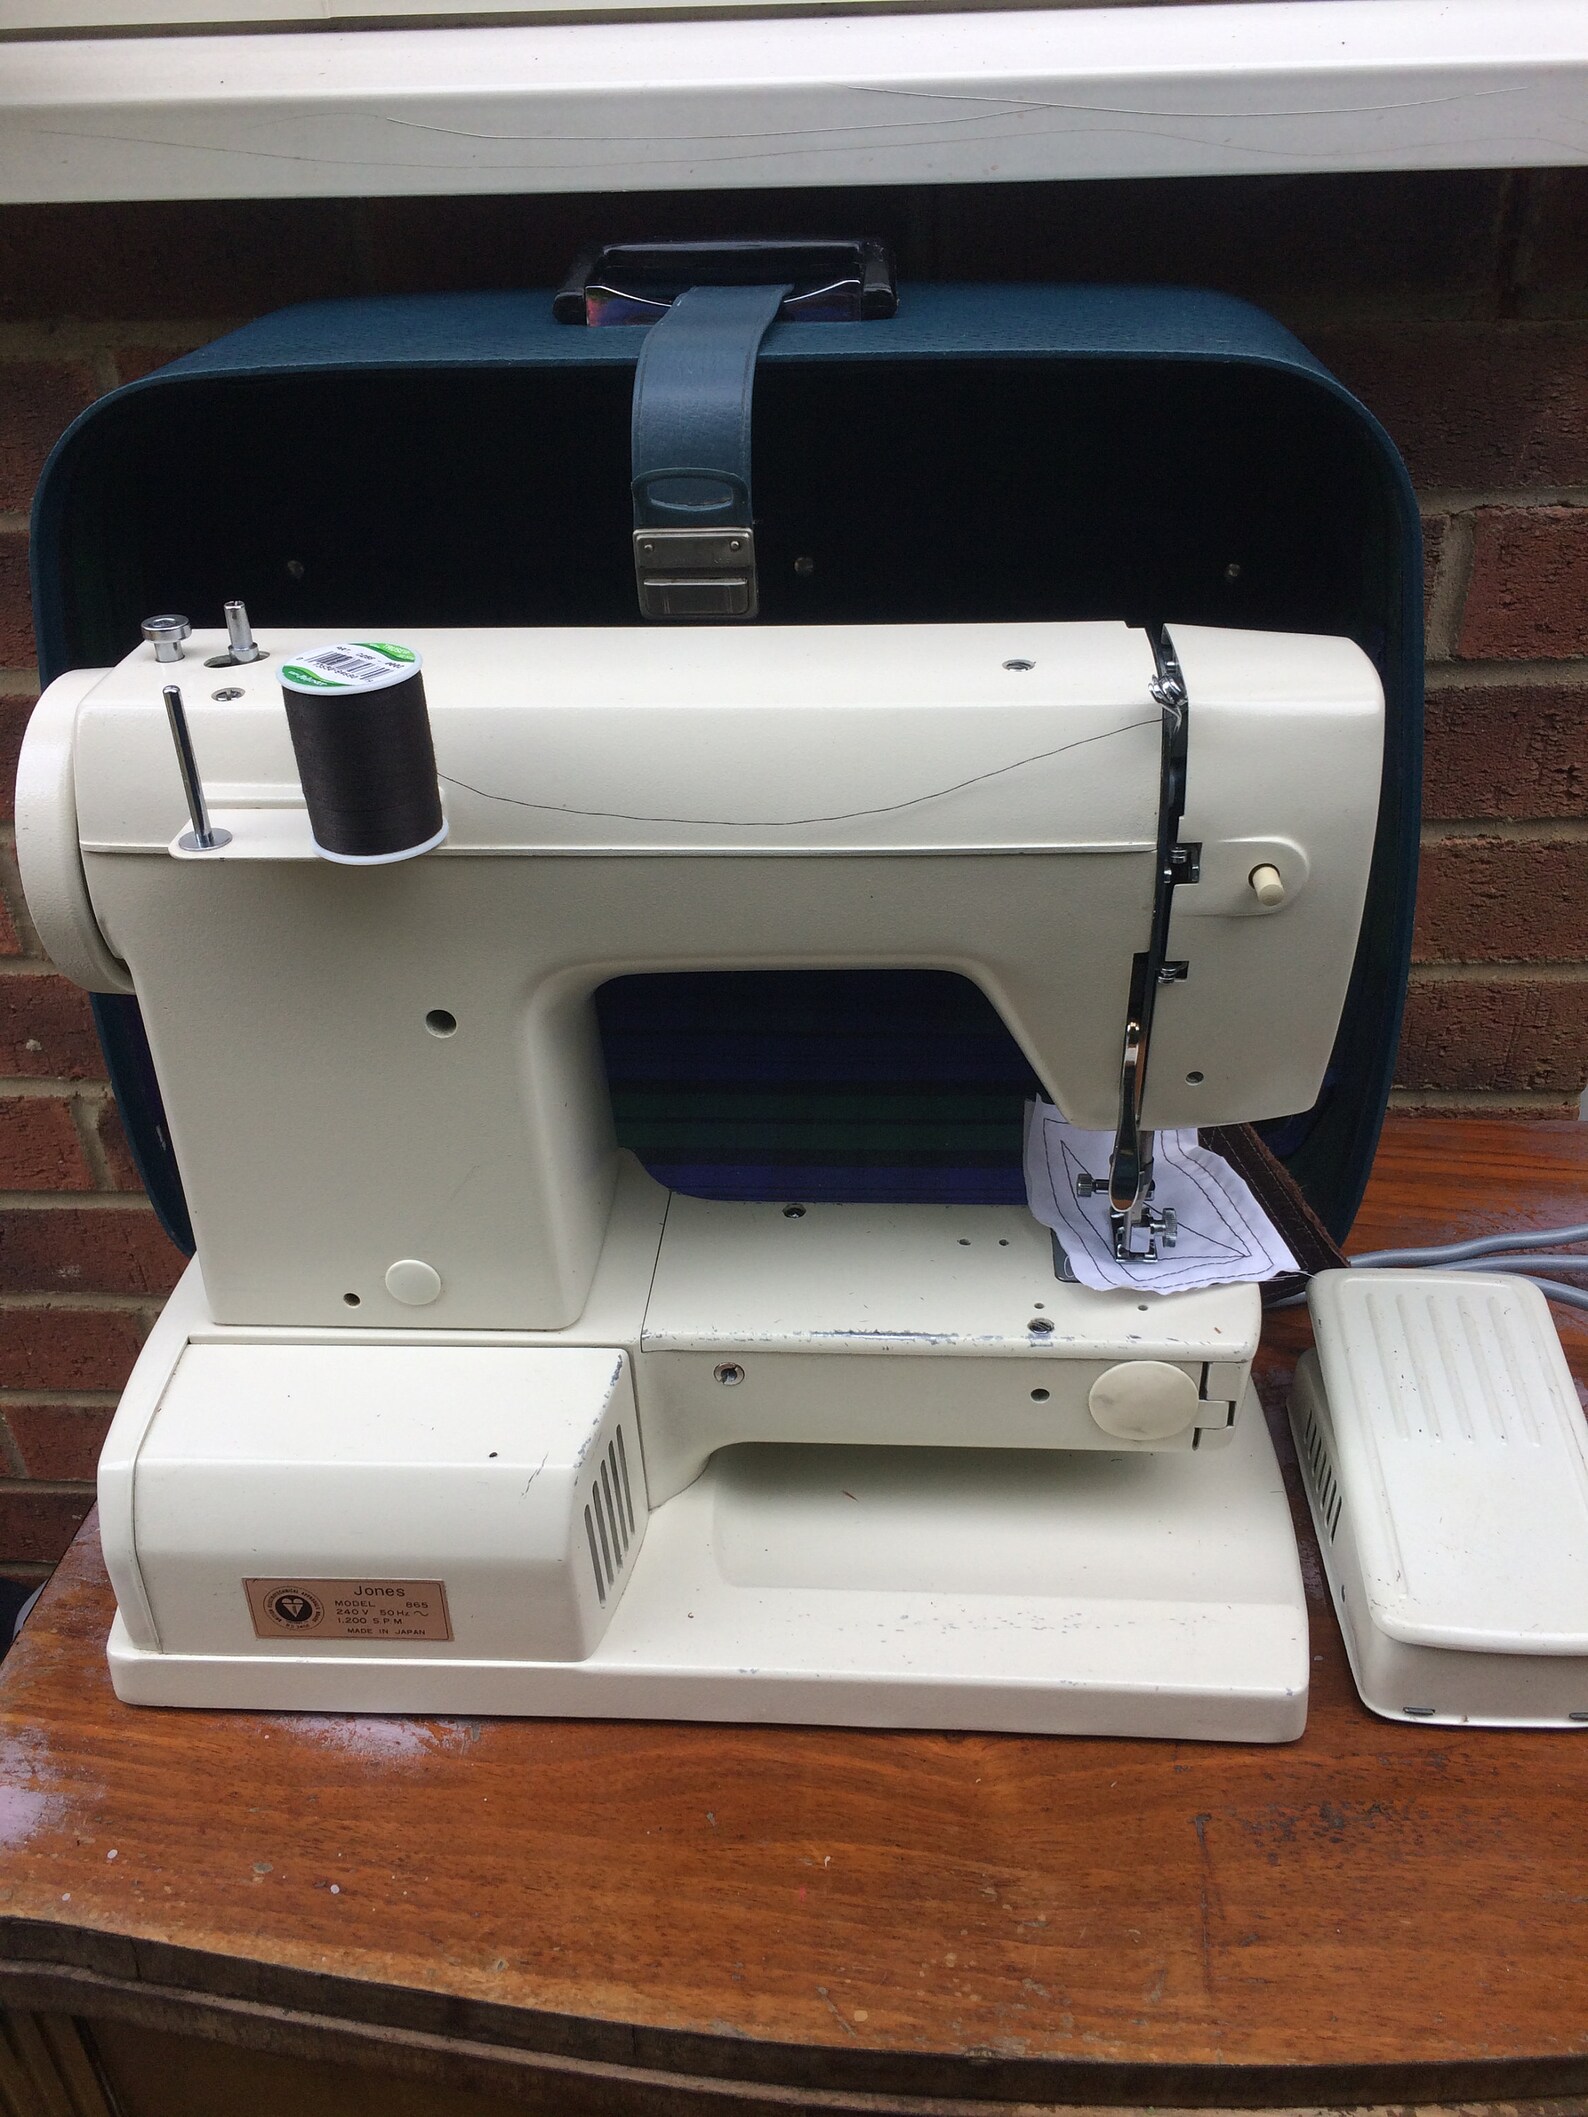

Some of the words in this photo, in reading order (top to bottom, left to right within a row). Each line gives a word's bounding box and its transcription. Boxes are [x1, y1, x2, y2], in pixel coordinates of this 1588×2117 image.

[354, 1585, 405, 1597] Jones
[335, 1600, 376, 1608] MODEL
[405, 1601, 429, 1609] 865
